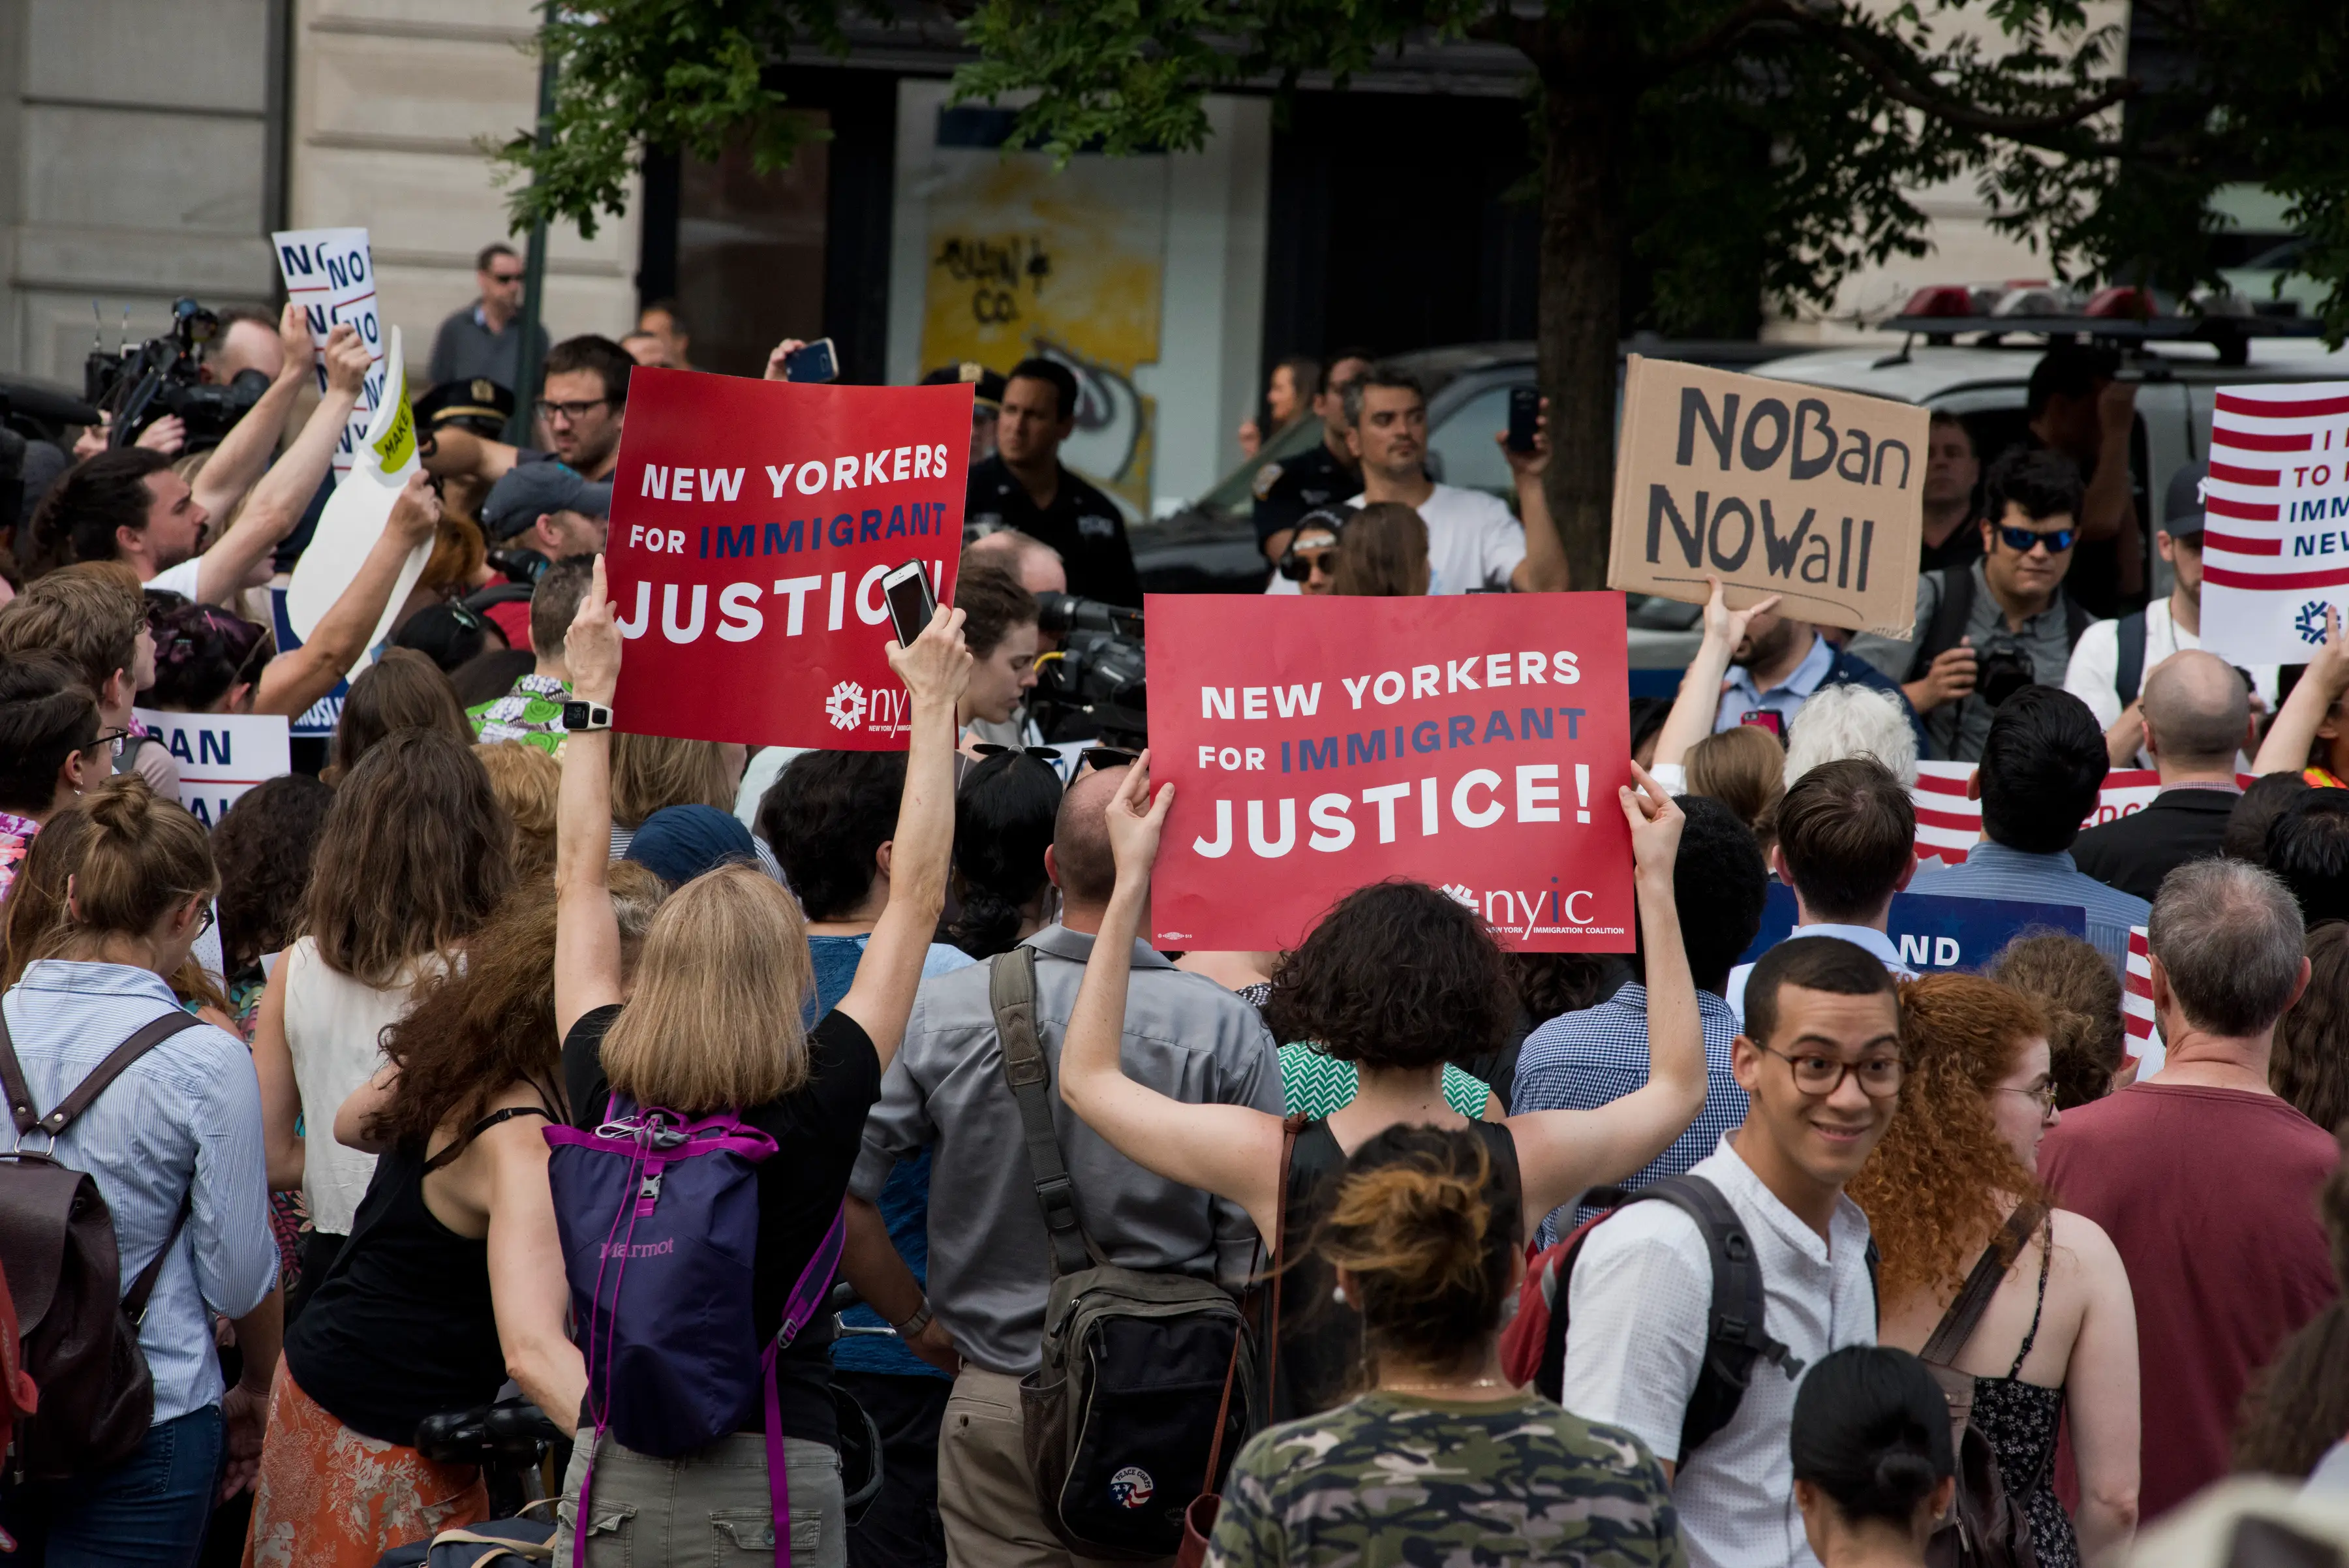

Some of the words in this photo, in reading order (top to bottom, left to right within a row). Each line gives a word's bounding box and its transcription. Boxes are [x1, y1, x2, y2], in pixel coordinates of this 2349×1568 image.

[327, 251, 365, 290] NO
[384, 407, 410, 461] MAKE
[641, 463, 746, 502] NEW
[765, 444, 947, 499] YORKERS
[2294, 464, 2331, 488] TO
[630, 524, 686, 554] FOR
[699, 502, 947, 559] IMMIGRANT
[615, 560, 942, 645] JUSTIC!
[1201, 682, 1323, 720] NEW
[1342, 650, 1581, 710] YORKERS
[1198, 745, 1266, 771] FOR
[1281, 707, 1587, 773] IMMIGRANT
[1192, 763, 1591, 859] JUSTICE!
[1485, 876, 1594, 940] nyic
[599, 1237, 674, 1259] Marmot
[1115, 1469, 1136, 1481] PEACE
[1137, 1471, 1151, 1488] CORPS
